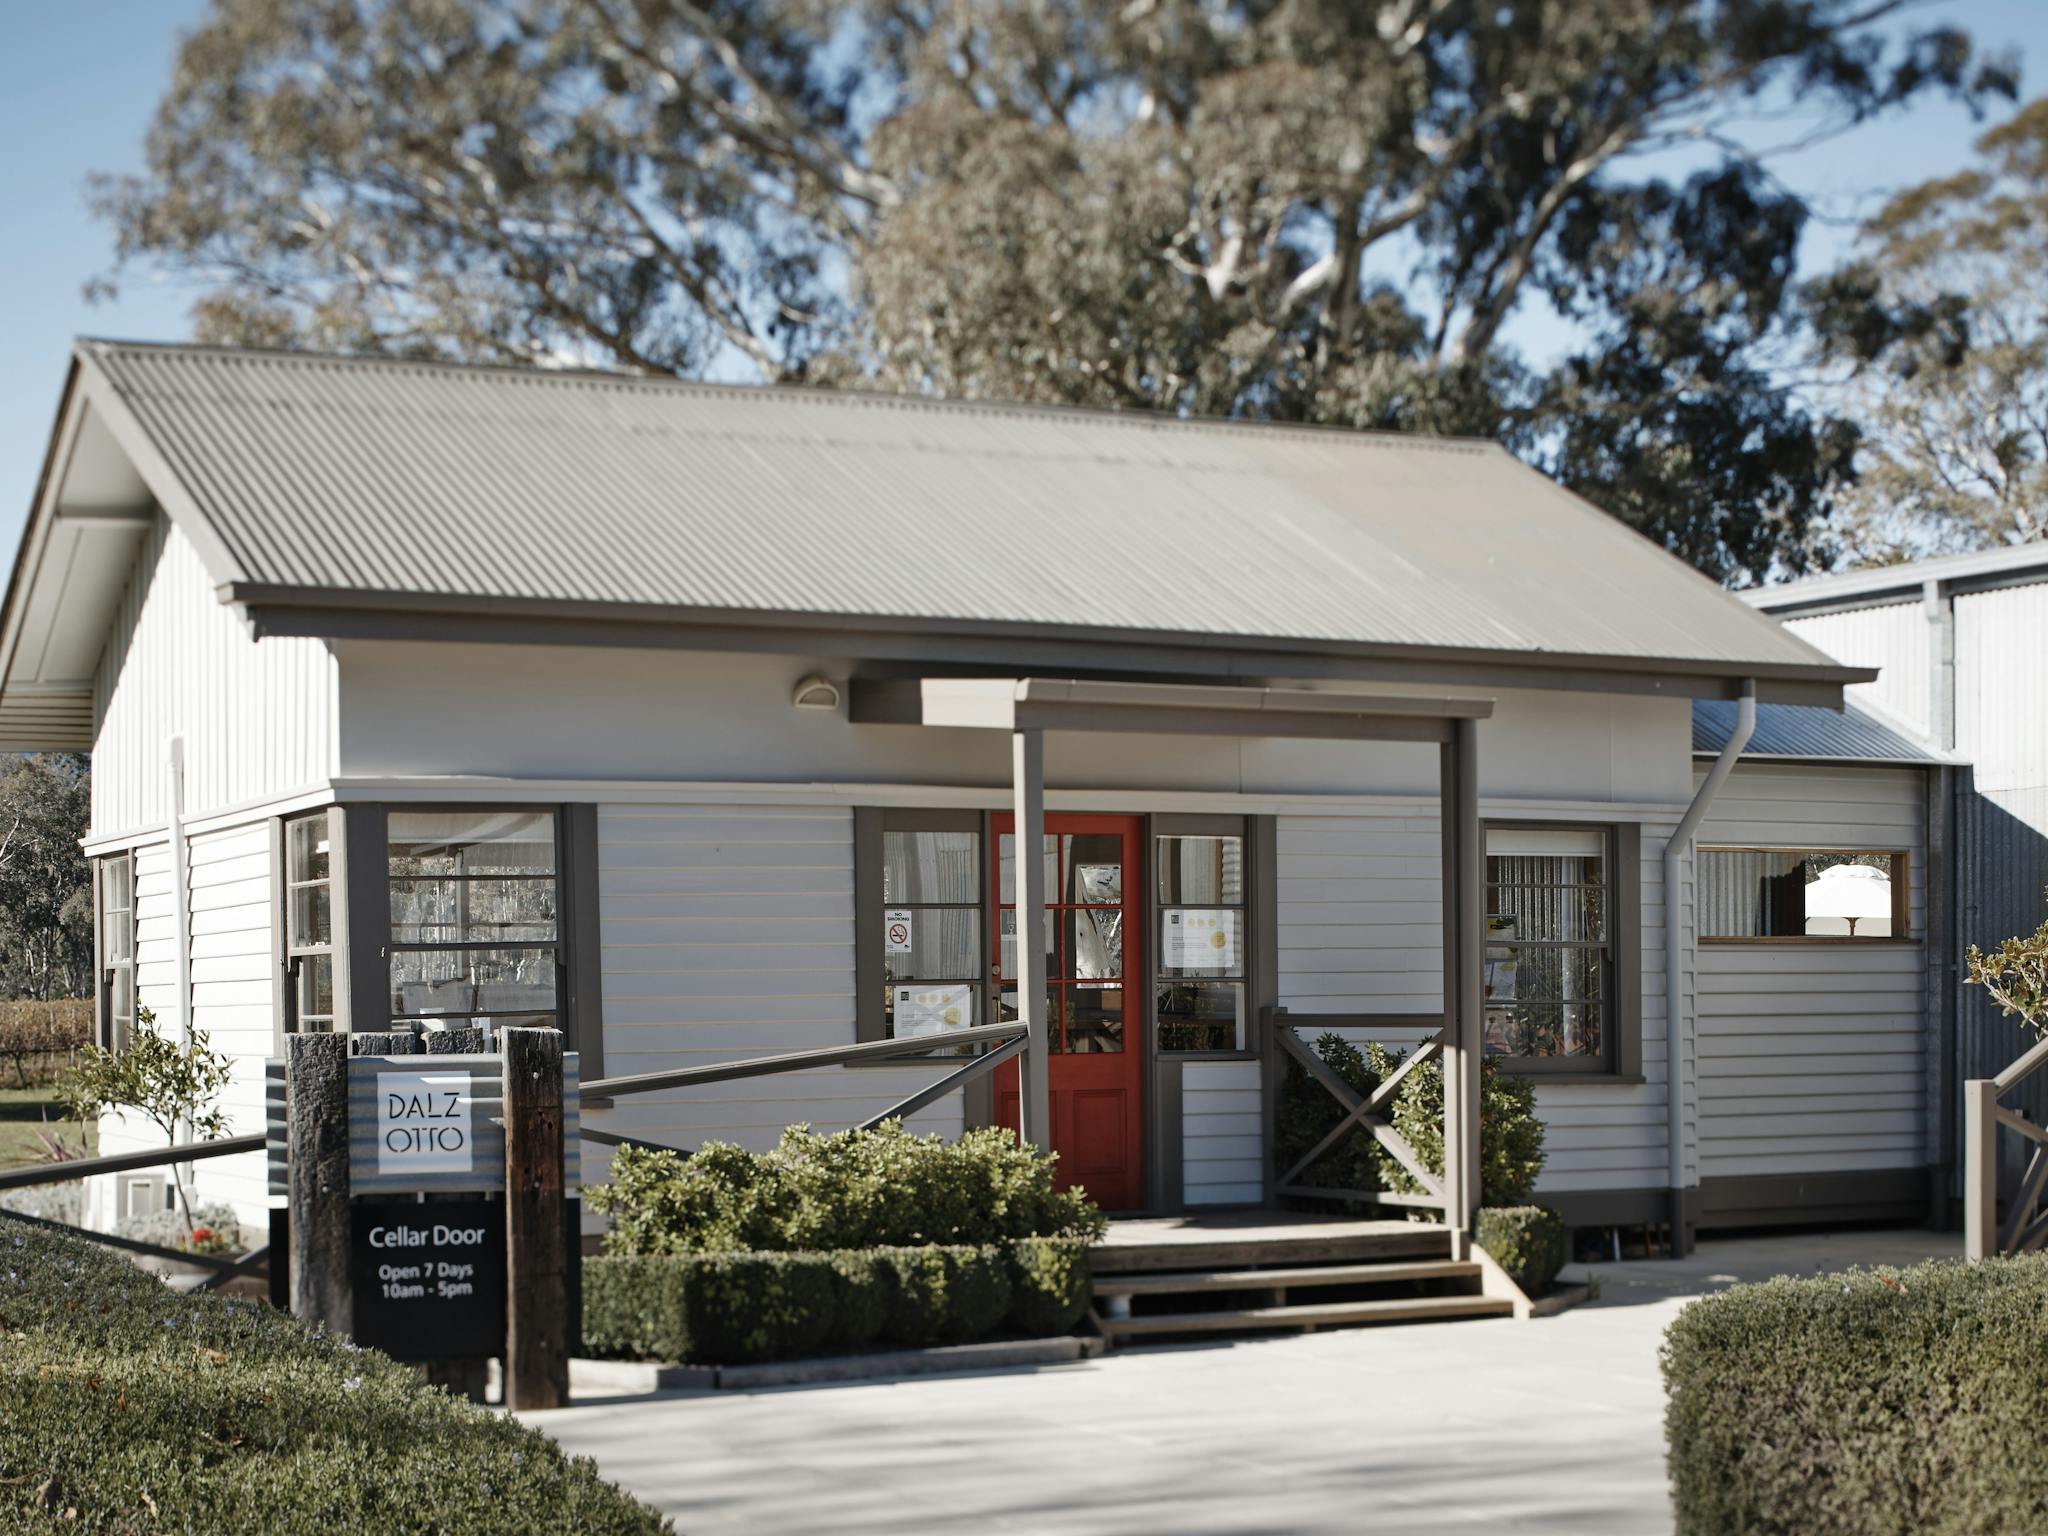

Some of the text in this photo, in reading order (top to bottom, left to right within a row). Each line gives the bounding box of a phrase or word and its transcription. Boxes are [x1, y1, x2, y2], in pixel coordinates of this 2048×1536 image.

[389, 1093, 461, 1119] DALZ
[386, 1127, 463, 1153] OTTO
[369, 1225, 485, 1248] Cellar Door
[378, 1262, 474, 1282] Open 7 Days
[382, 1283, 424, 1299] 10am
[438, 1281, 473, 1299] 5pm
